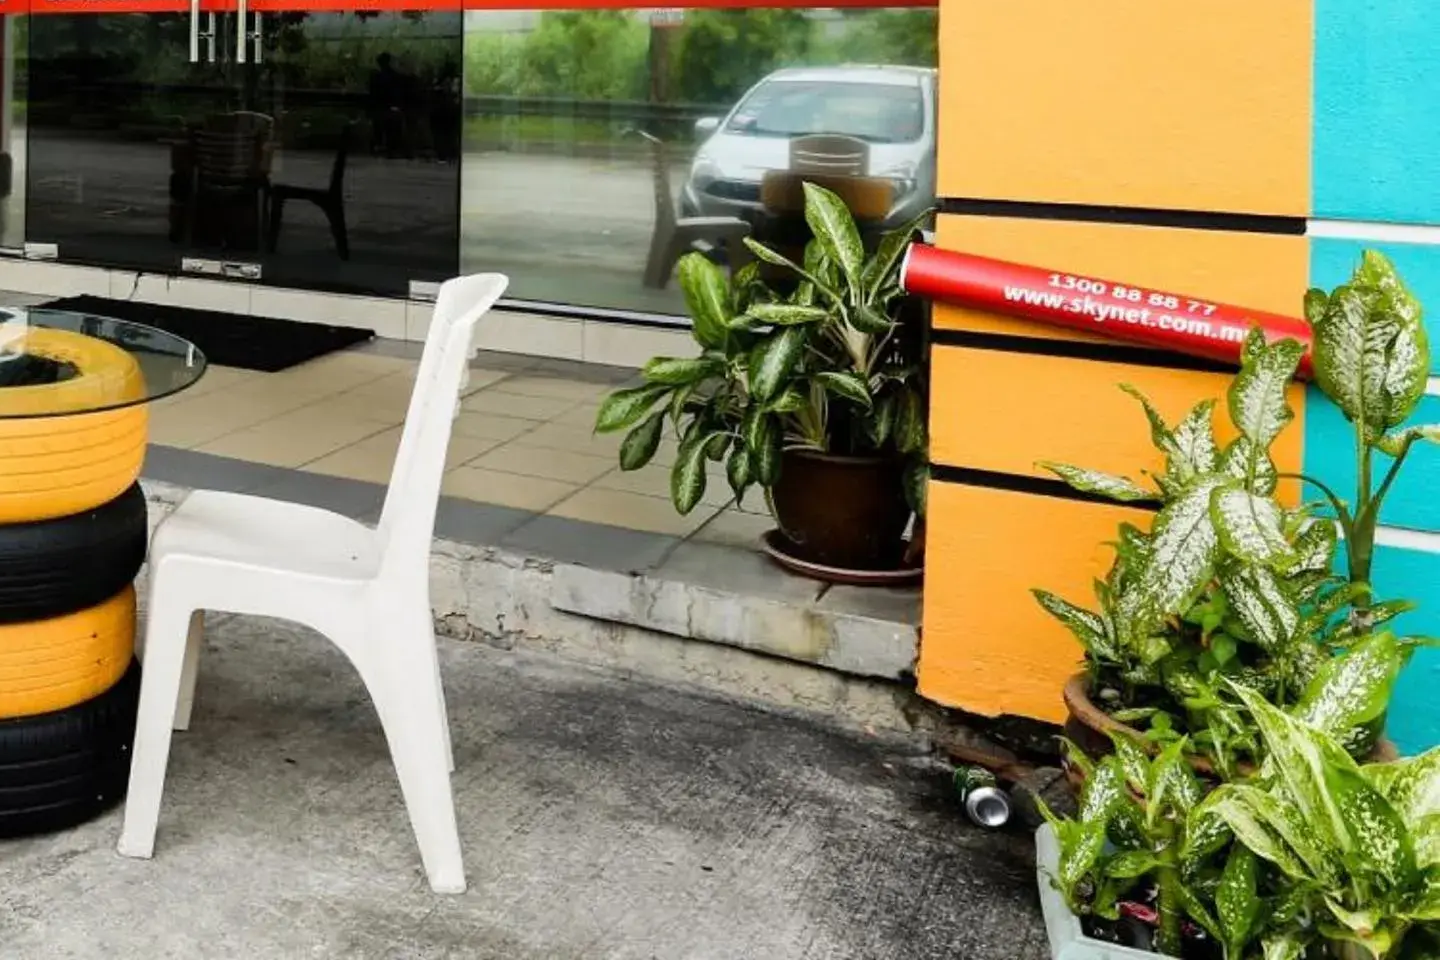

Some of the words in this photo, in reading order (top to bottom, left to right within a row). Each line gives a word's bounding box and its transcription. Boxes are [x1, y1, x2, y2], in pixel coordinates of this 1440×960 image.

[1047, 273, 1107, 296] 1300
[1112, 286, 1142, 303] 88
[1147, 292, 1180, 310] 88
[1186, 300, 1217, 316] 77
